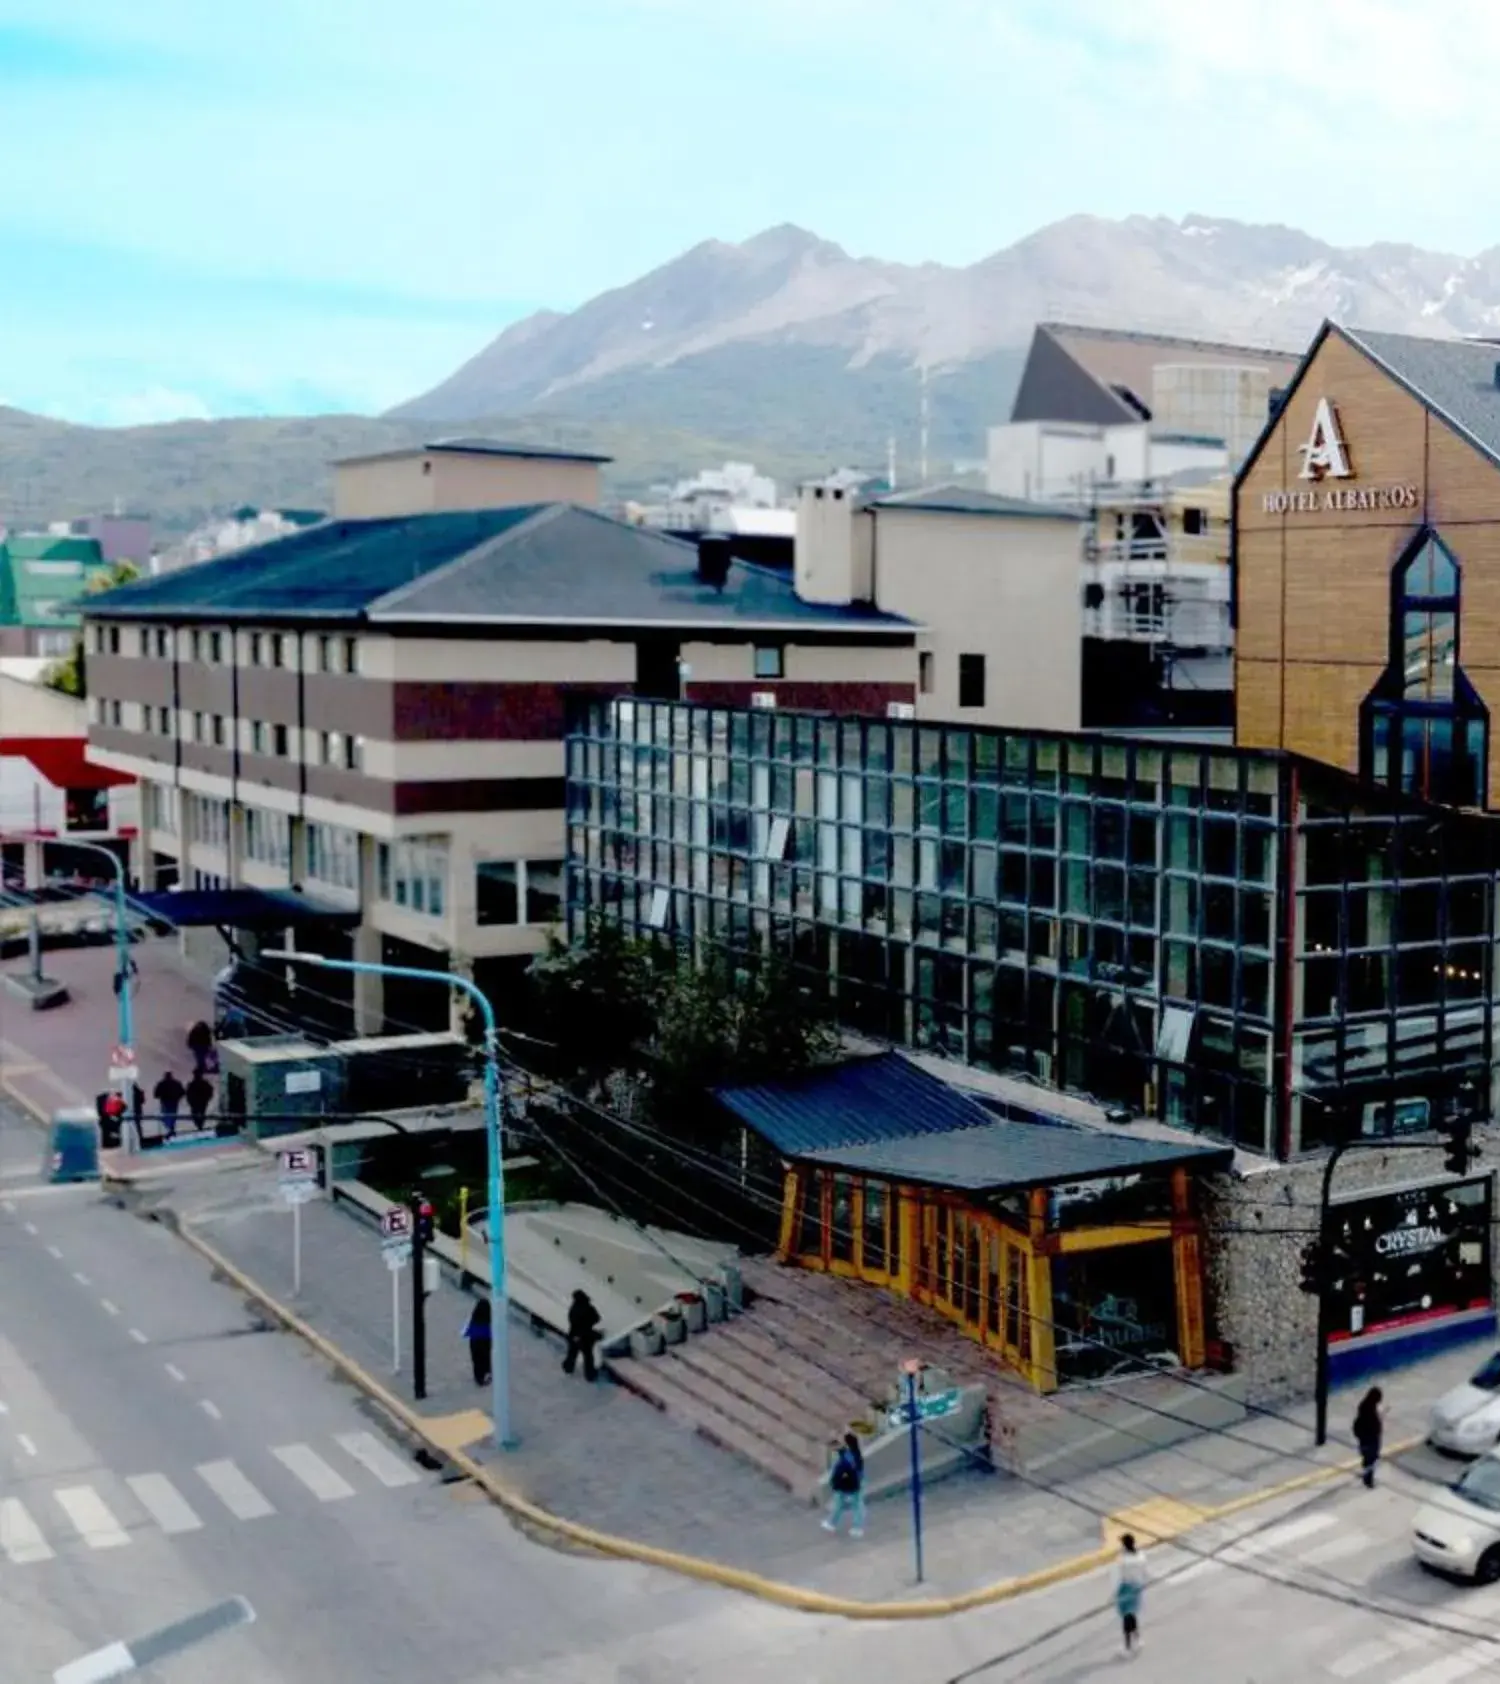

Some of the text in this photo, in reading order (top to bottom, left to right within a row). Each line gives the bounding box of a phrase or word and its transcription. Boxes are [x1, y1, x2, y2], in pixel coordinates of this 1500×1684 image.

[1297, 397, 1352, 480] A
[1262, 484, 1418, 513] HOTEL ALBATROS
[289, 1151, 306, 1170] E
[389, 1211, 407, 1232] E
[1375, 1225, 1444, 1254] CRYSTAL
